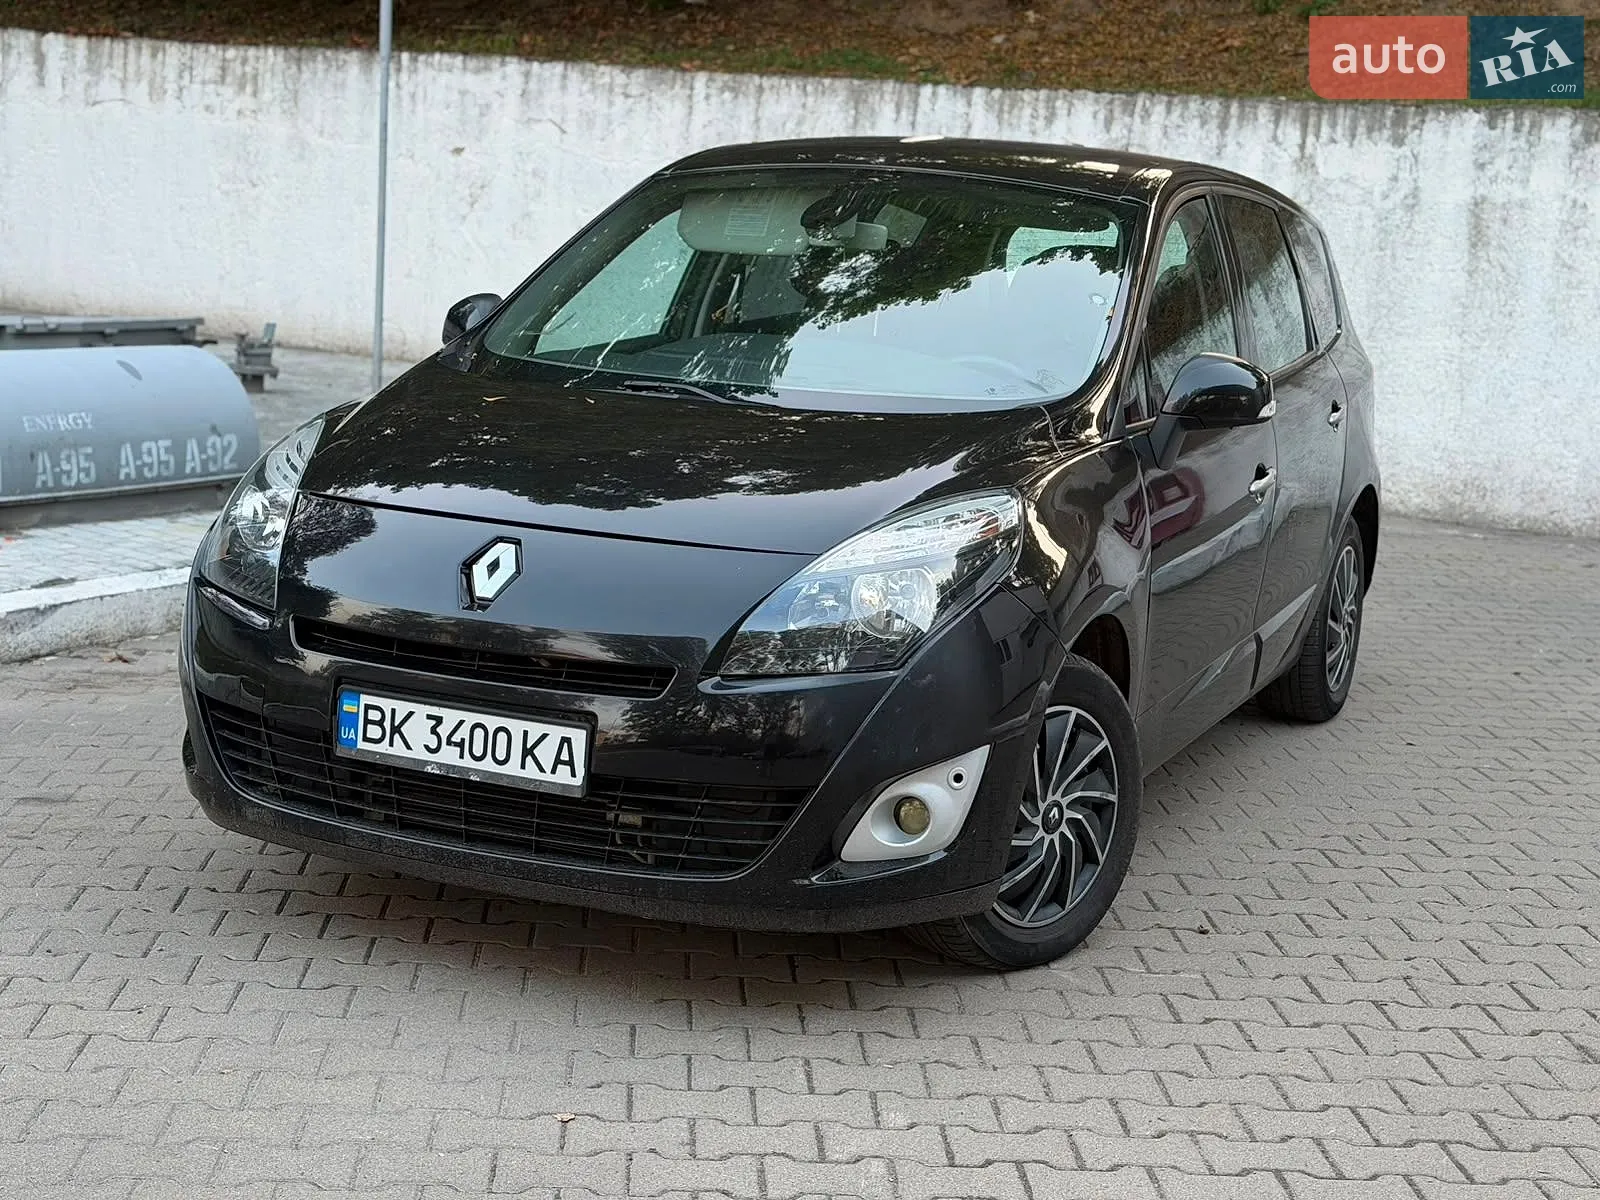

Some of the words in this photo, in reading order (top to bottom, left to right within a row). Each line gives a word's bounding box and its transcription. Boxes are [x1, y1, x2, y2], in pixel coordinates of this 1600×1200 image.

[35, 446, 97, 489] A-95
[119, 439, 176, 481] A-95
[184, 433, 238, 475] A-92
[341, 726, 356, 741] UA
